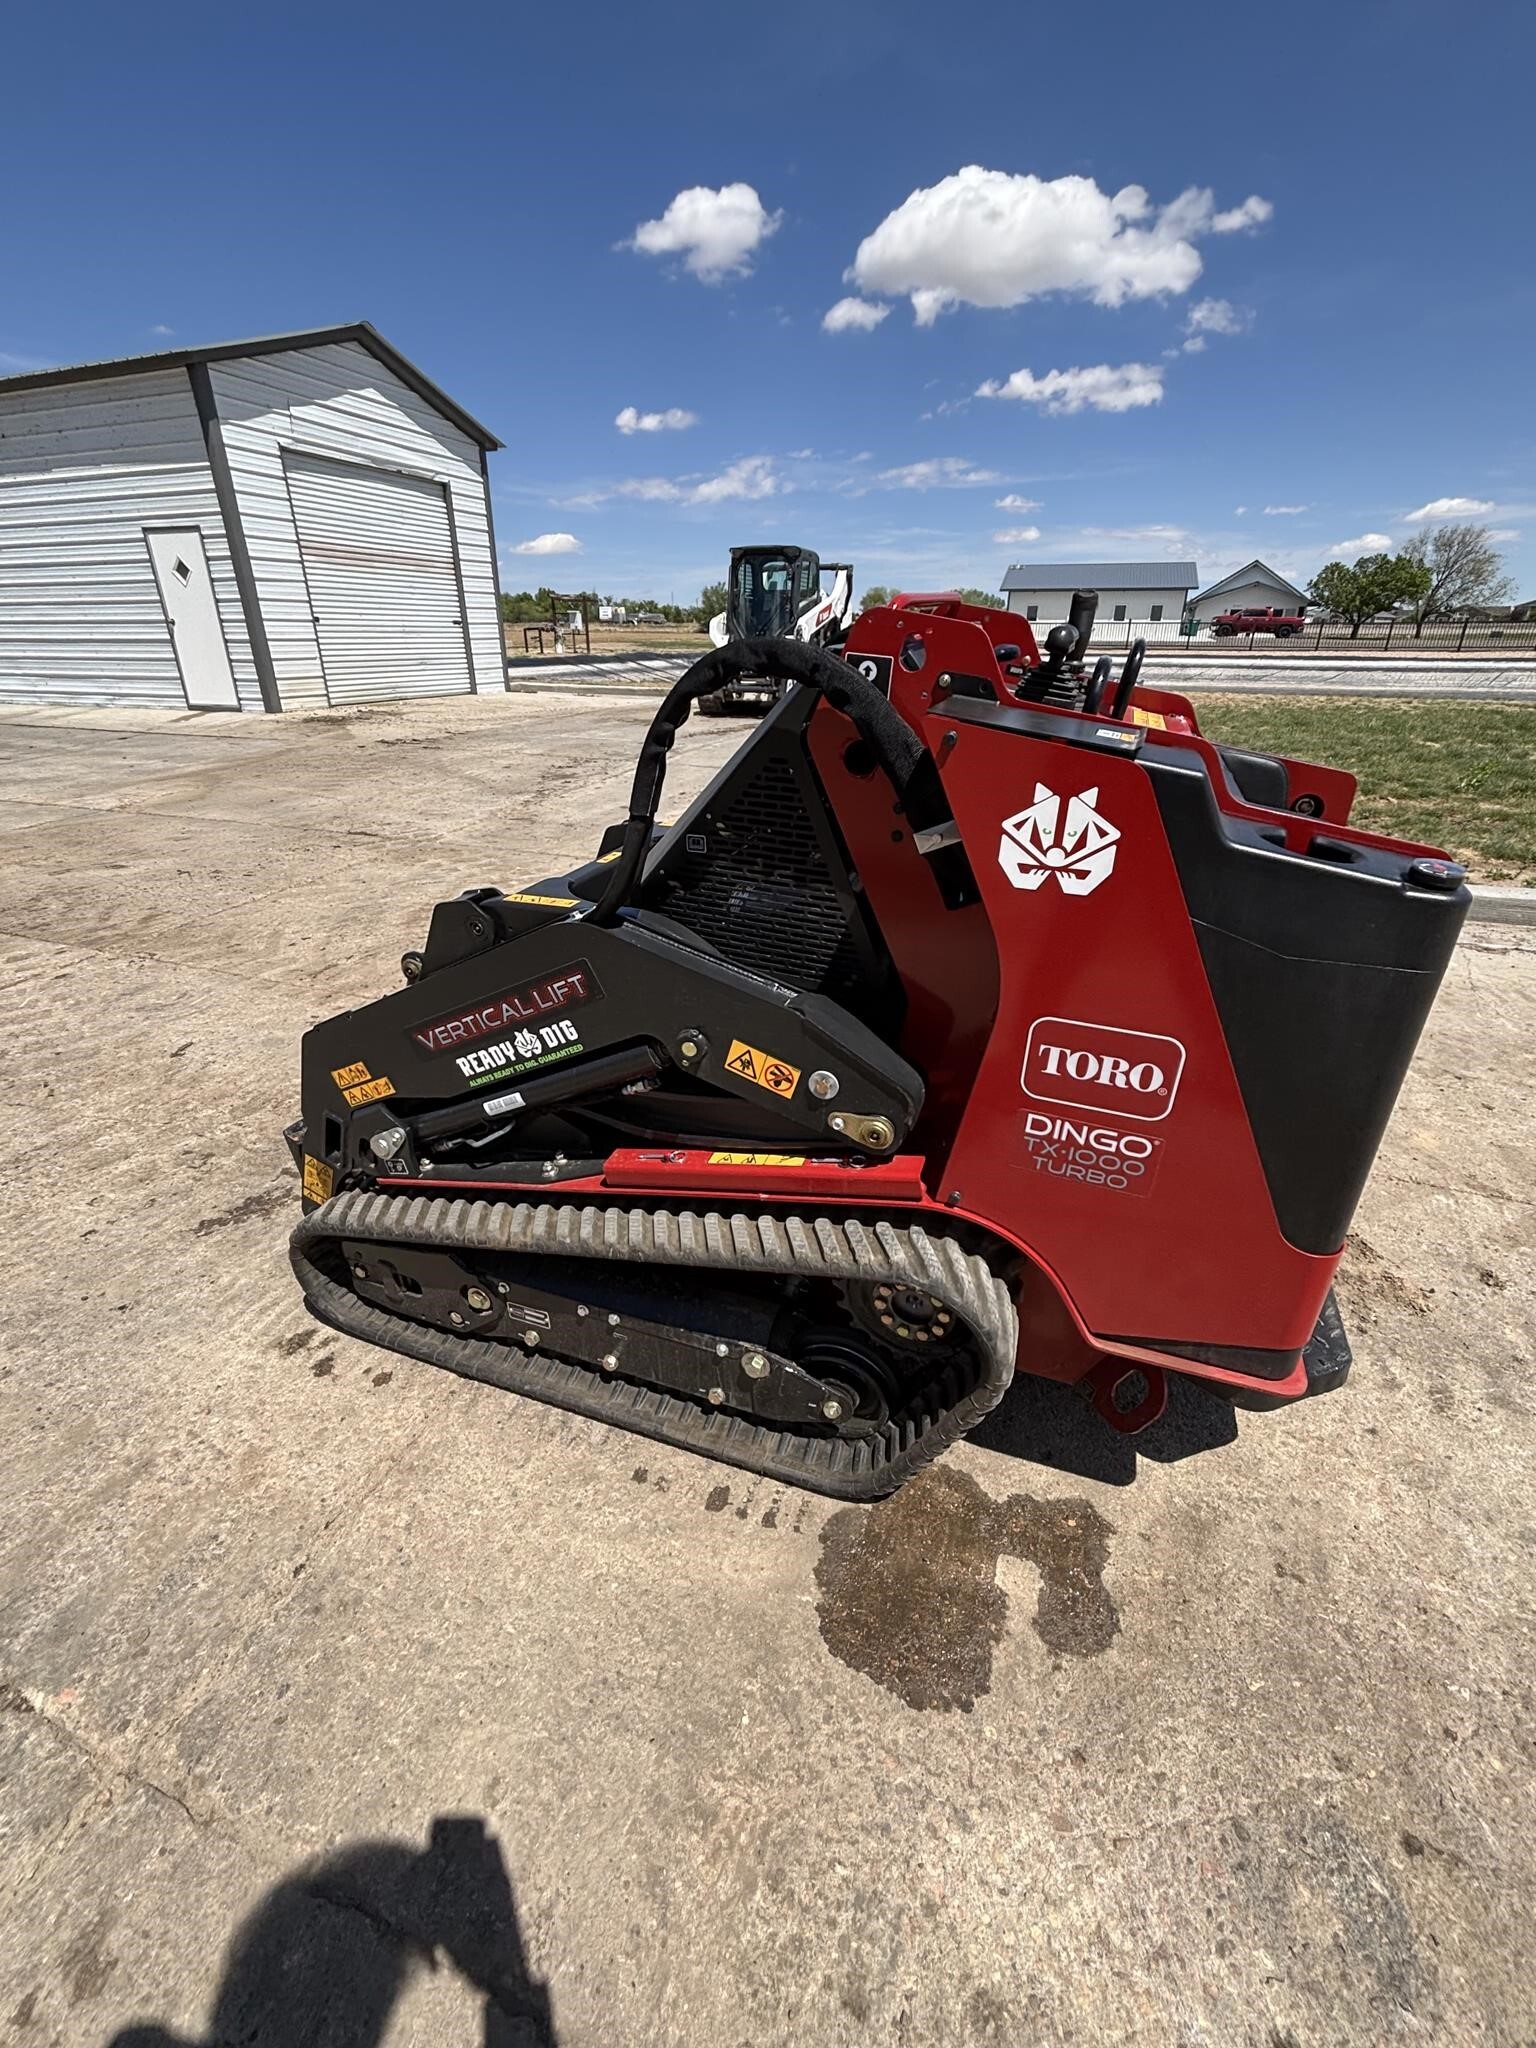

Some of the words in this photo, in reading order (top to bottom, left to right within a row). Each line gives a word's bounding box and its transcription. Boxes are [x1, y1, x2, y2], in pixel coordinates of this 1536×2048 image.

[417, 998, 534, 1049] VERTICAL
[533, 974, 585, 1009] LIFT
[455, 1040, 517, 1077] READY
[539, 1019, 579, 1049] DIG
[468, 1073, 495, 1088] ALWAYS
[494, 1067, 515, 1080] READY
[514, 1064, 525, 1074] TO
[538, 1043, 584, 1064] GUARANTEED
[1024, 1112, 1153, 1158] DINGO
[1033, 1155, 1128, 1190] TURBO
